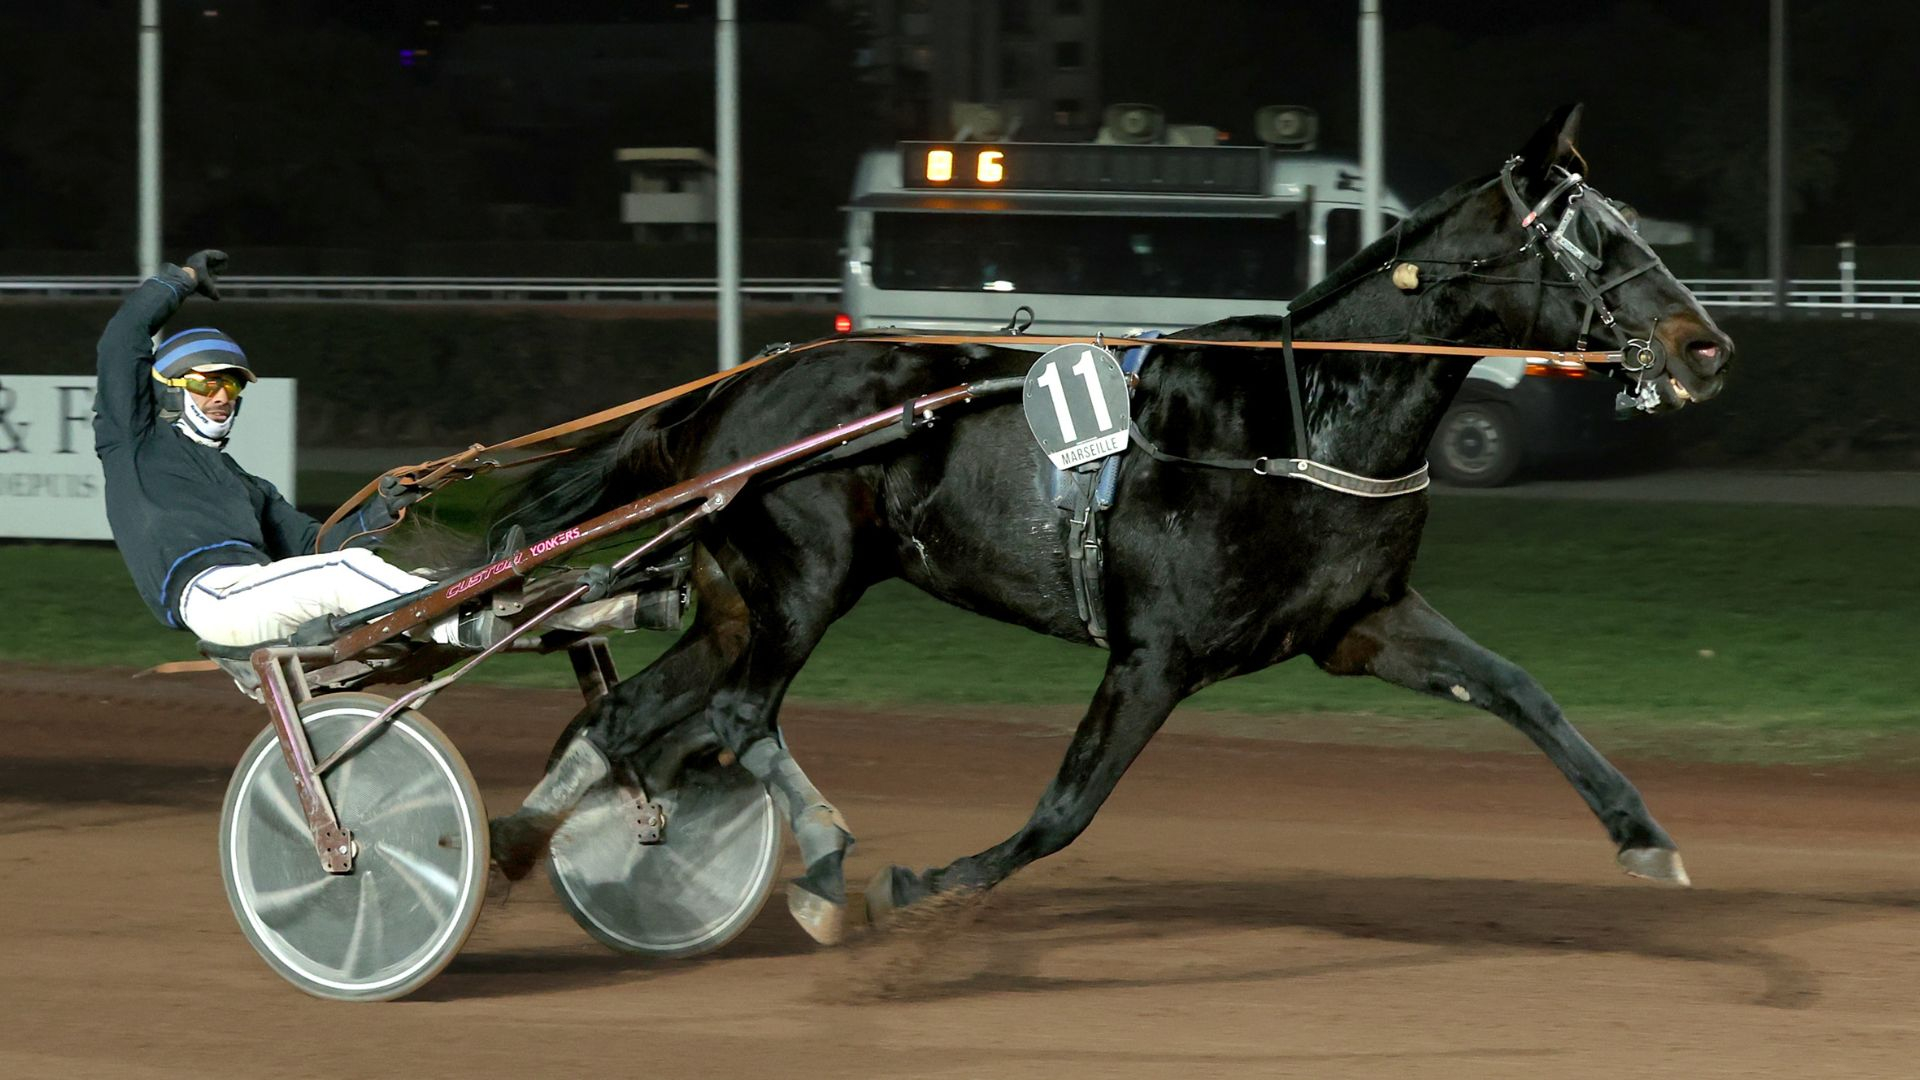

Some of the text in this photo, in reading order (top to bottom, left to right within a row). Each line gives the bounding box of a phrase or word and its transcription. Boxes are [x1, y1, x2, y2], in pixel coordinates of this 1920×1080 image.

[977, 151, 1003, 182] 6
[1037, 350, 1113, 444] 11
[1061, 437, 1118, 465] MARSEILLE
[529, 527, 580, 556] YONKERS
